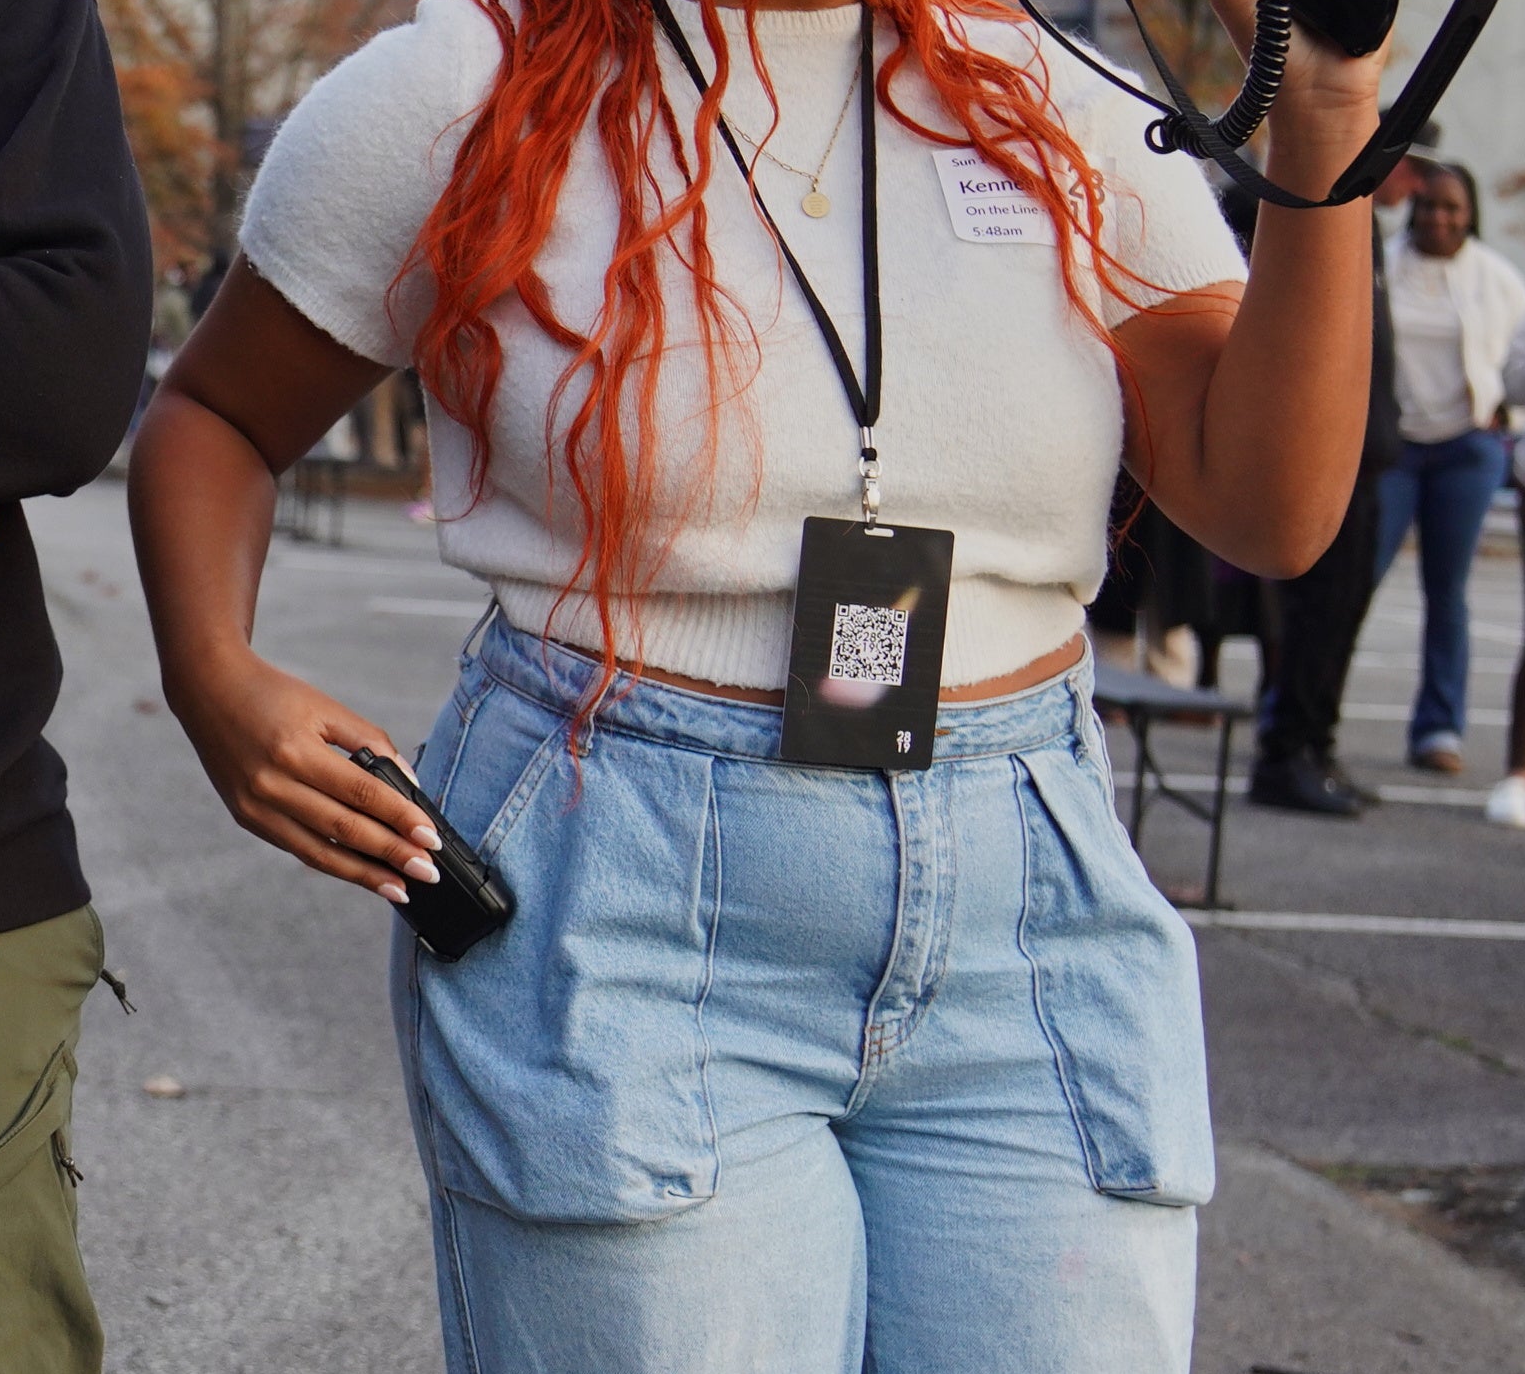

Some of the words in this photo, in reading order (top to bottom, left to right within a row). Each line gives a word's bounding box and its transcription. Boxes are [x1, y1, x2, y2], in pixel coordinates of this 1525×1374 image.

[951, 156, 977, 168] Sun
[966, 205, 986, 216] On
[988, 204, 1009, 215] the
[1012, 204, 1038, 215] Line
[972, 226, 1023, 238] 5:48am
[896, 730, 912, 743] 28
[896, 741, 912, 754] 19
